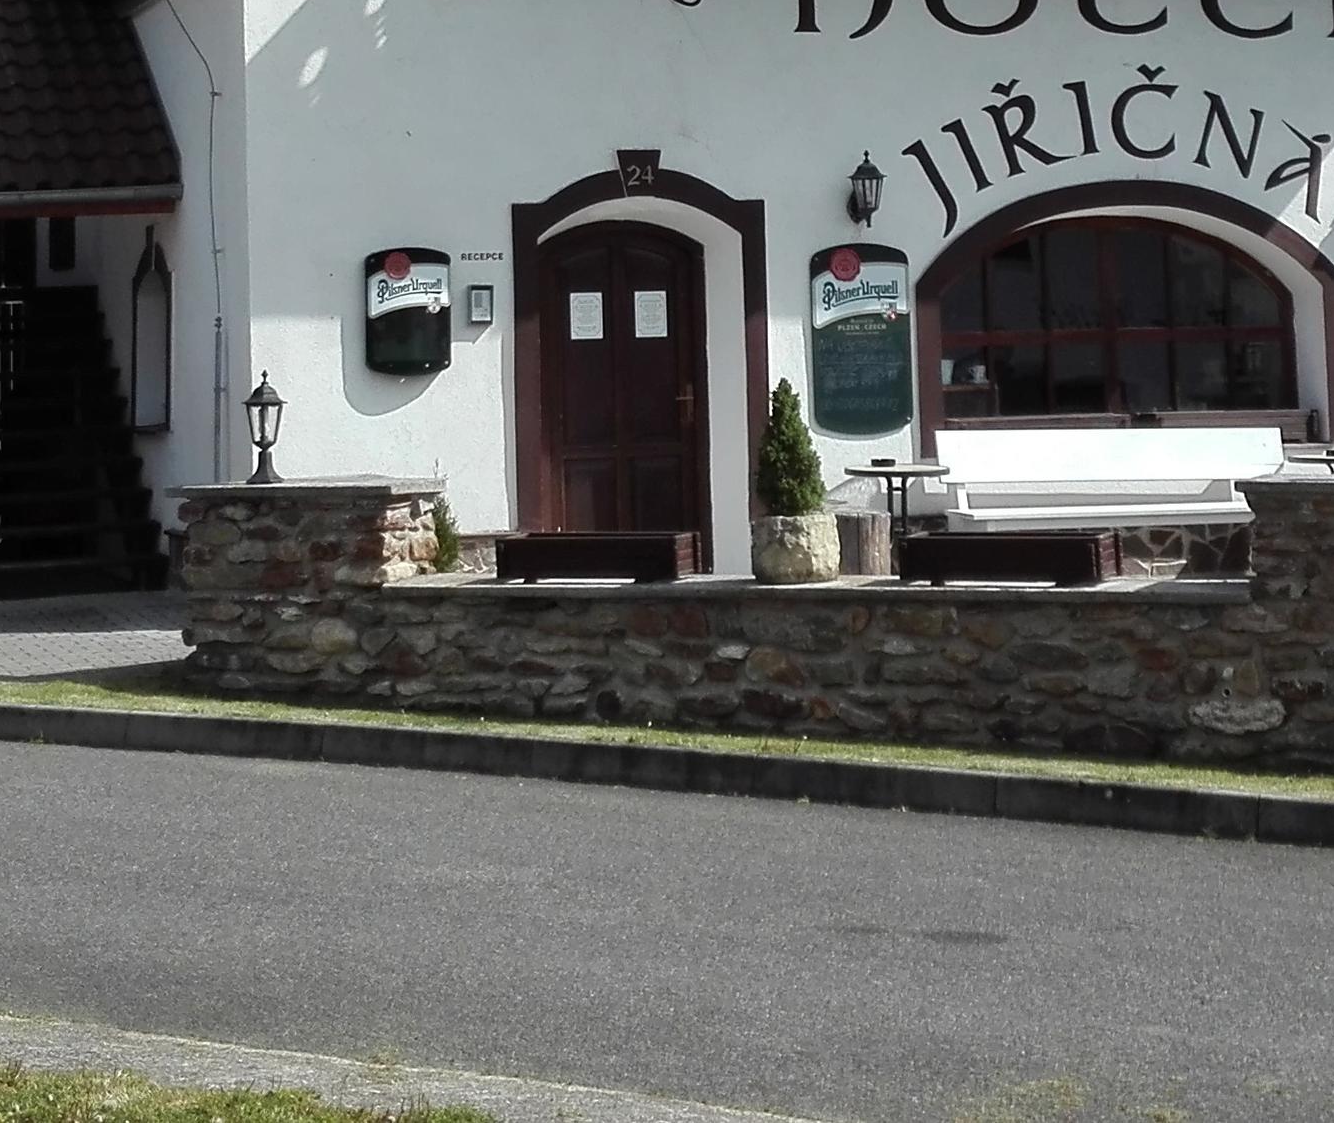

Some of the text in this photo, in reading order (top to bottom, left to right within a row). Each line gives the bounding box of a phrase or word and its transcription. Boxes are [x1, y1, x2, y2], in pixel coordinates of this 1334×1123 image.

[626, 164, 655, 187] 24
[460, 252, 504, 261] RECEPCE
[377, 278, 443, 304] Pilsner Urquell
[822, 279, 899, 311] Pilsner Urquell
